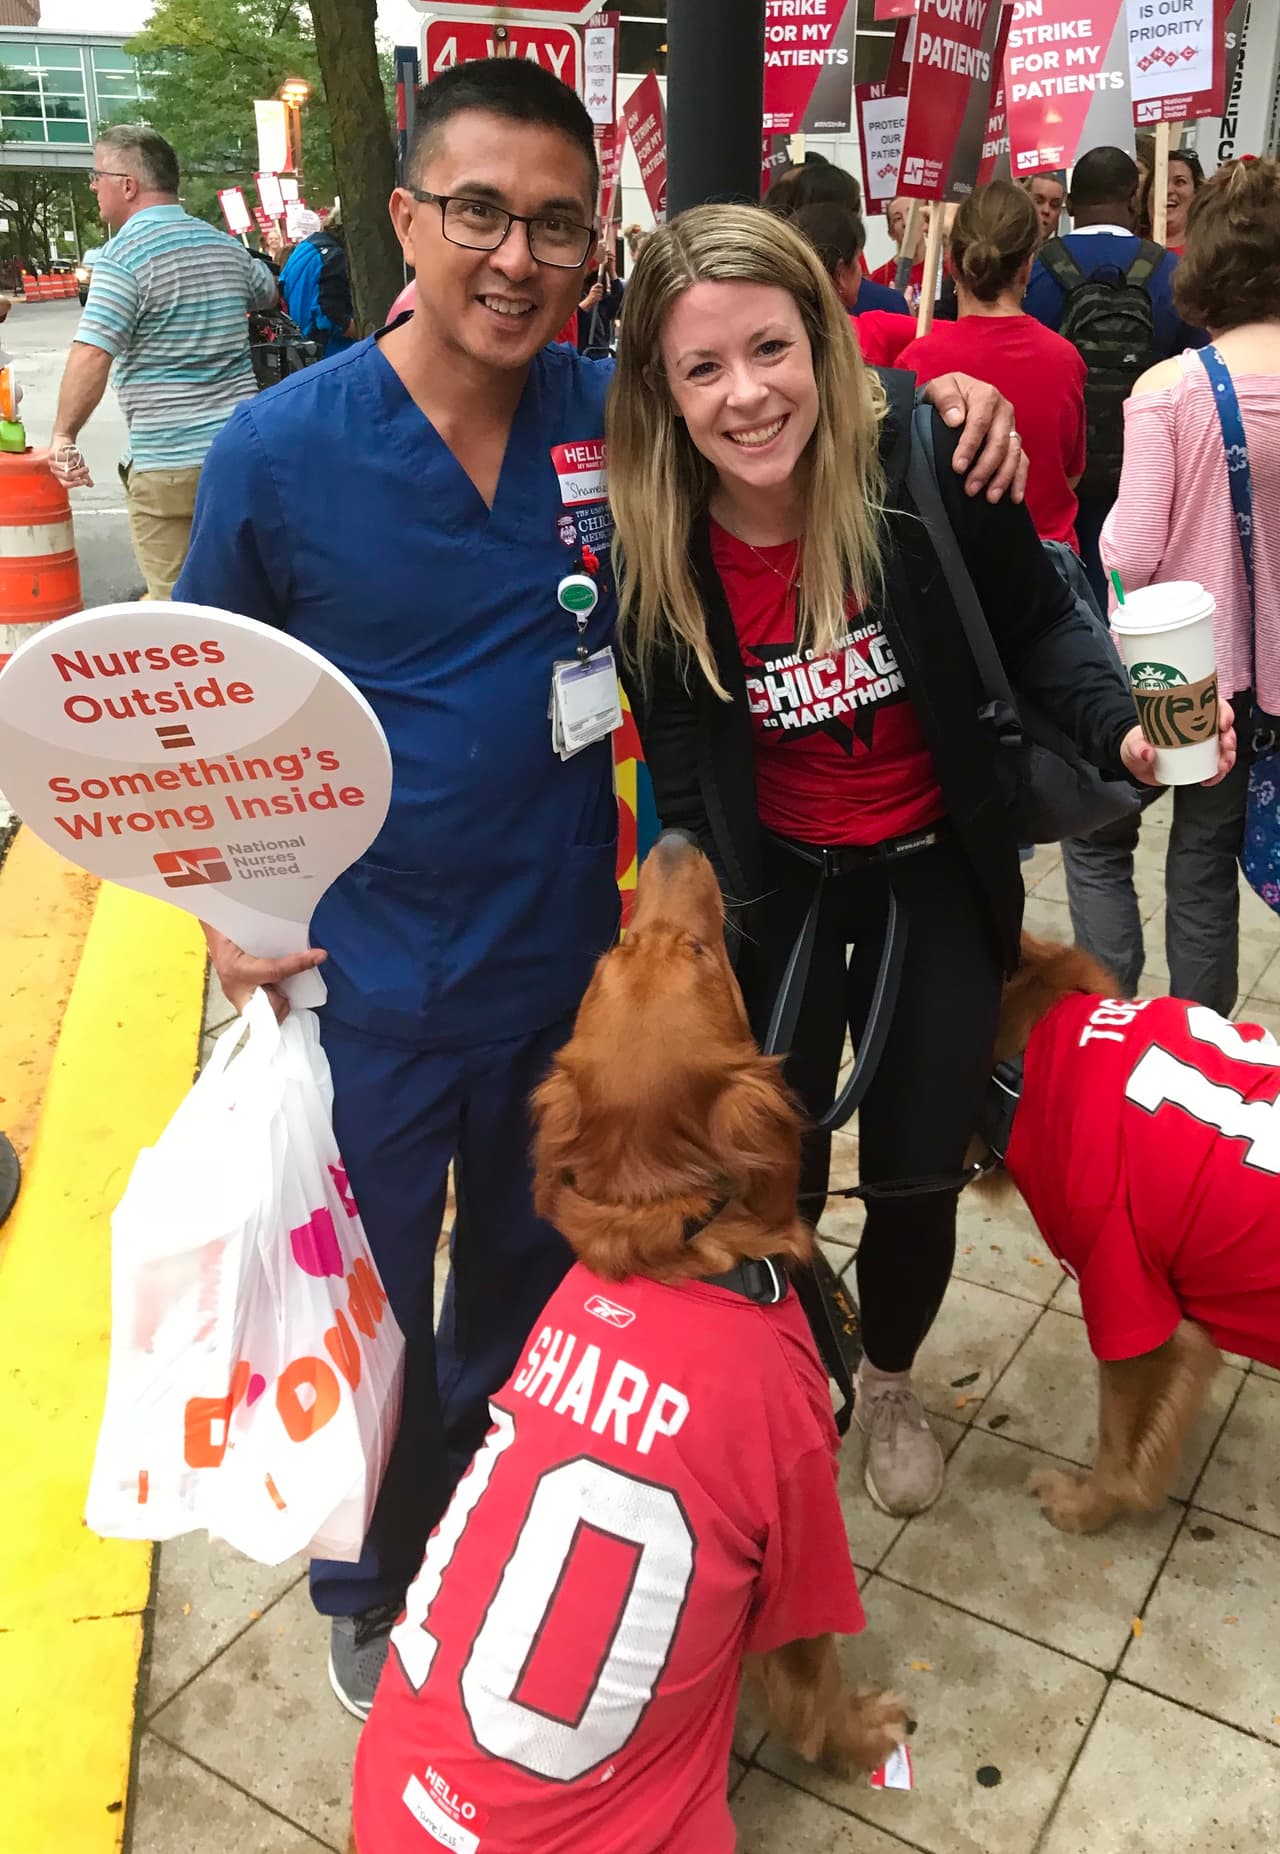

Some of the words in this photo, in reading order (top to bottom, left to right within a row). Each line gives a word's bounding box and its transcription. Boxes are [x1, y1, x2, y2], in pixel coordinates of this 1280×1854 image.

[964, 0, 987, 30] MY
[1140, 5, 1153, 19] IS
[1159, 0, 1193, 15] OUR
[802, 24, 832, 41] MY
[1008, 19, 1092, 48] STRIKE
[1130, 19, 1203, 42] PRIORITY
[918, 32, 990, 82] PATIENTS
[1010, 51, 1059, 75] FOR
[1065, 46, 1101, 66] MY
[1011, 71, 1125, 102] PATIENTS
[628, 111, 639, 129] ON
[632, 113, 656, 147] STRIKE
[869, 119, 905, 131] PROTEC
[988, 114, 1005, 133] MY
[637, 141, 652, 164] FOR
[650, 128, 663, 149] MY
[881, 134, 901, 145] OUR
[51, 640, 226, 682] Nurses
[764, 652, 802, 673] BANK
[63, 678, 256, 724] Outside
[779, 670, 906, 730] MARATHON
[48, 747, 341, 803] Something's
[54, 803, 215, 840] Wrong
[225, 783, 366, 820] Inside
[226, 835, 306, 855] National
[232, 852, 297, 868] Nurses
[238, 862, 301, 880] United
[513, 1326, 691, 1456] SHARP
[389, 1396, 698, 1786] 10
[425, 1765, 477, 1820] HELLO
